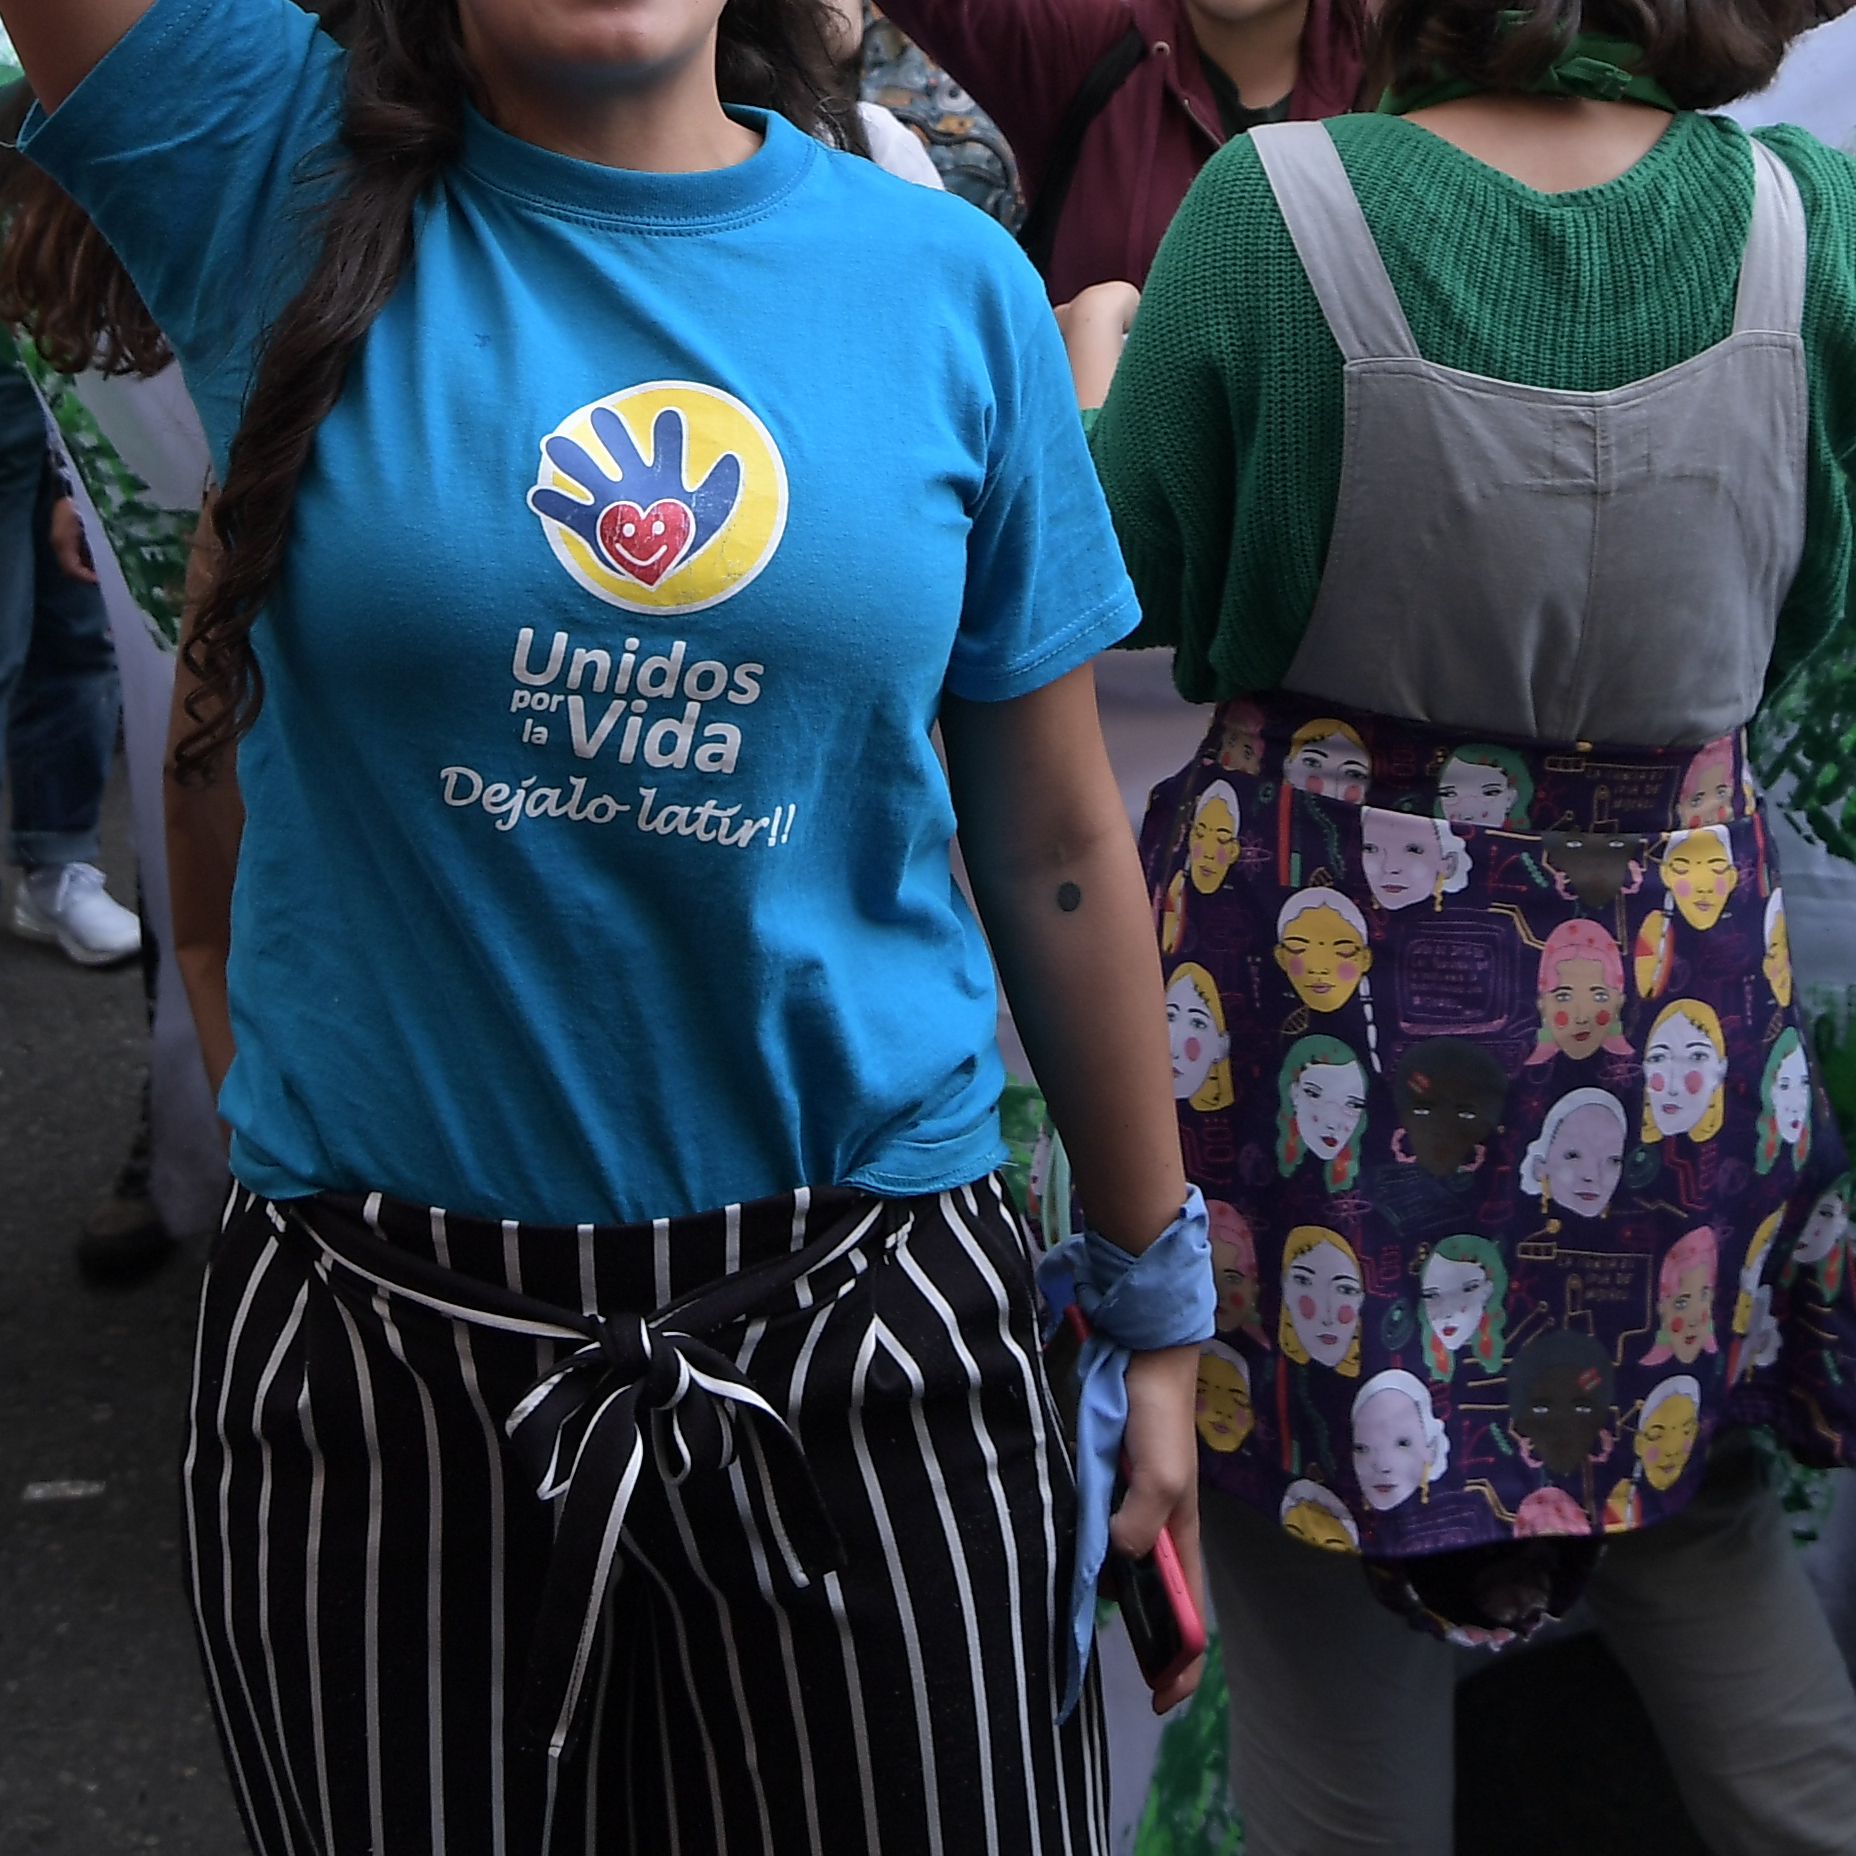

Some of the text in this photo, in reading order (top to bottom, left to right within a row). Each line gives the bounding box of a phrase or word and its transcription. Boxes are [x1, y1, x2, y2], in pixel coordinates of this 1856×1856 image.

[510, 626, 766, 705] Unidos
[510, 688, 565, 714] por
[521, 717, 549, 747] la
[566, 693, 744, 775] Vida
